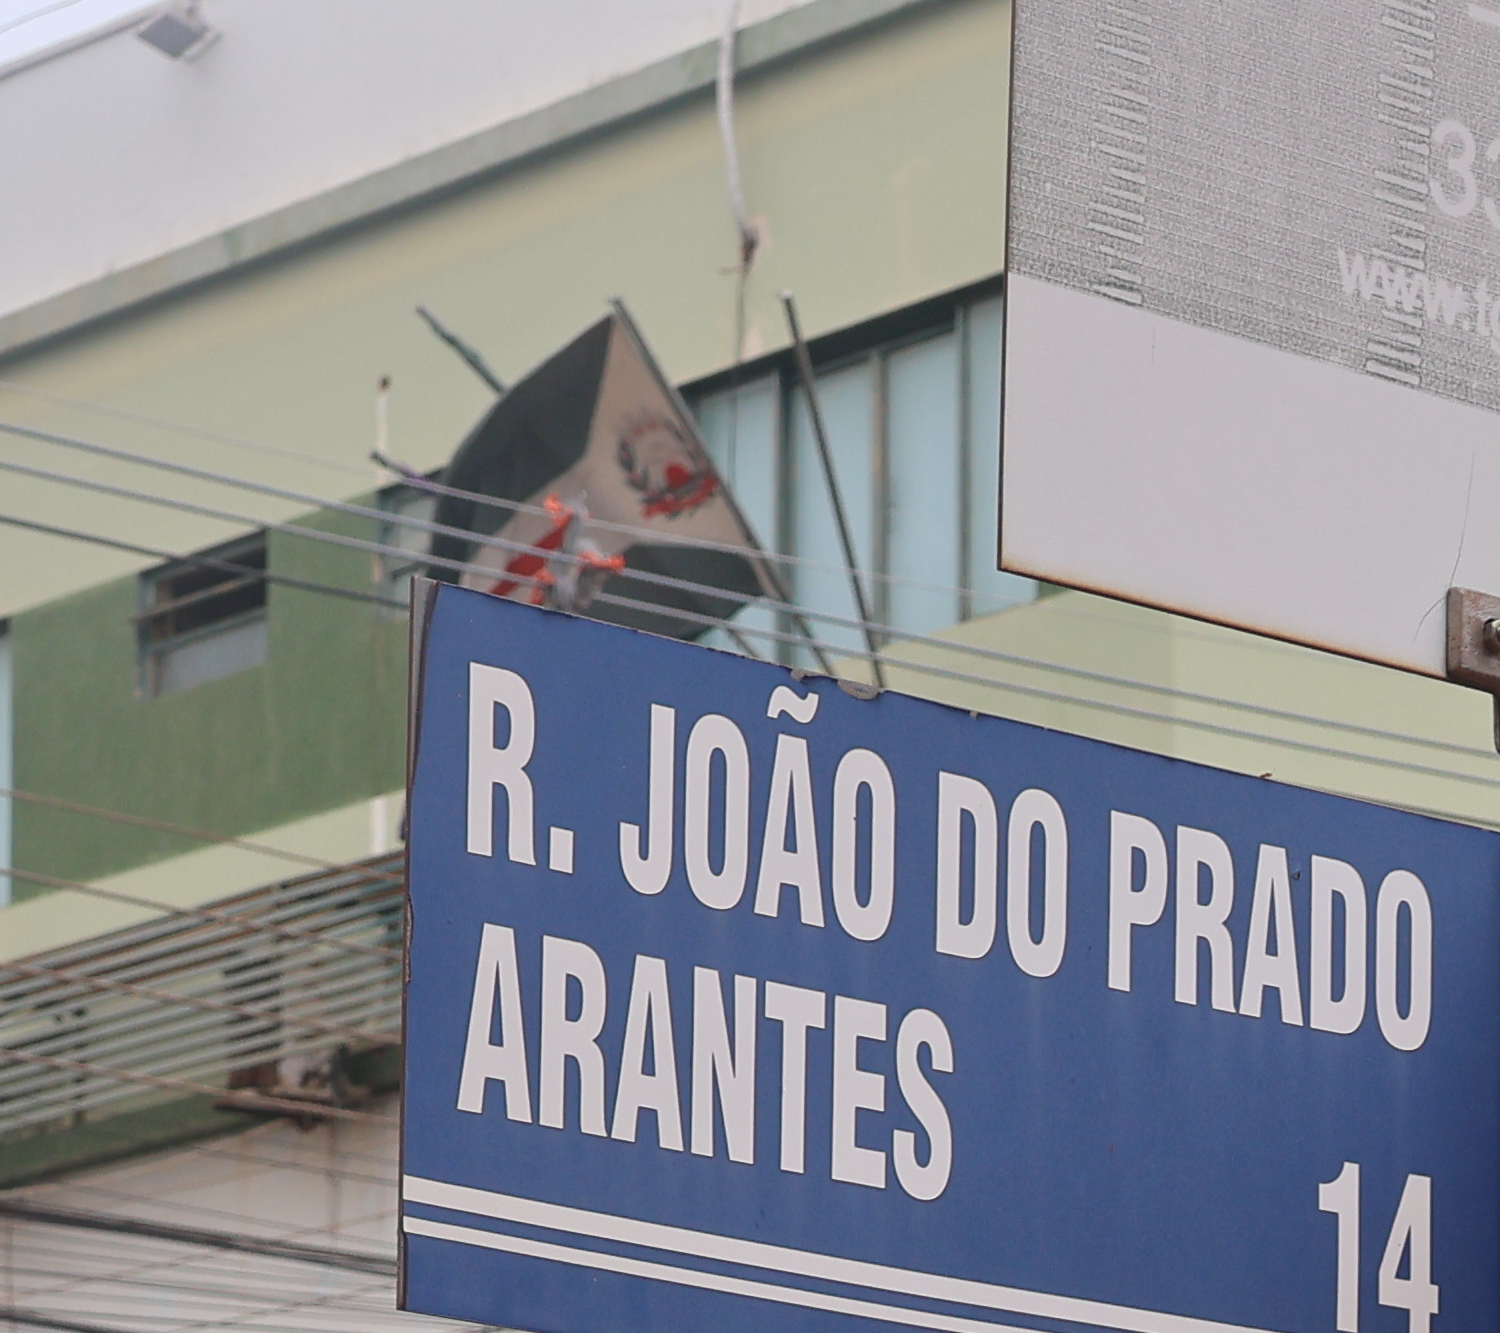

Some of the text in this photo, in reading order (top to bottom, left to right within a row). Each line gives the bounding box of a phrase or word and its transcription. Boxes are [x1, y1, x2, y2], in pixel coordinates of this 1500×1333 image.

[467, 660, 1432, 1051] R. JOÃO DO PRADO
[456, 922, 954, 1202] ARANTES
